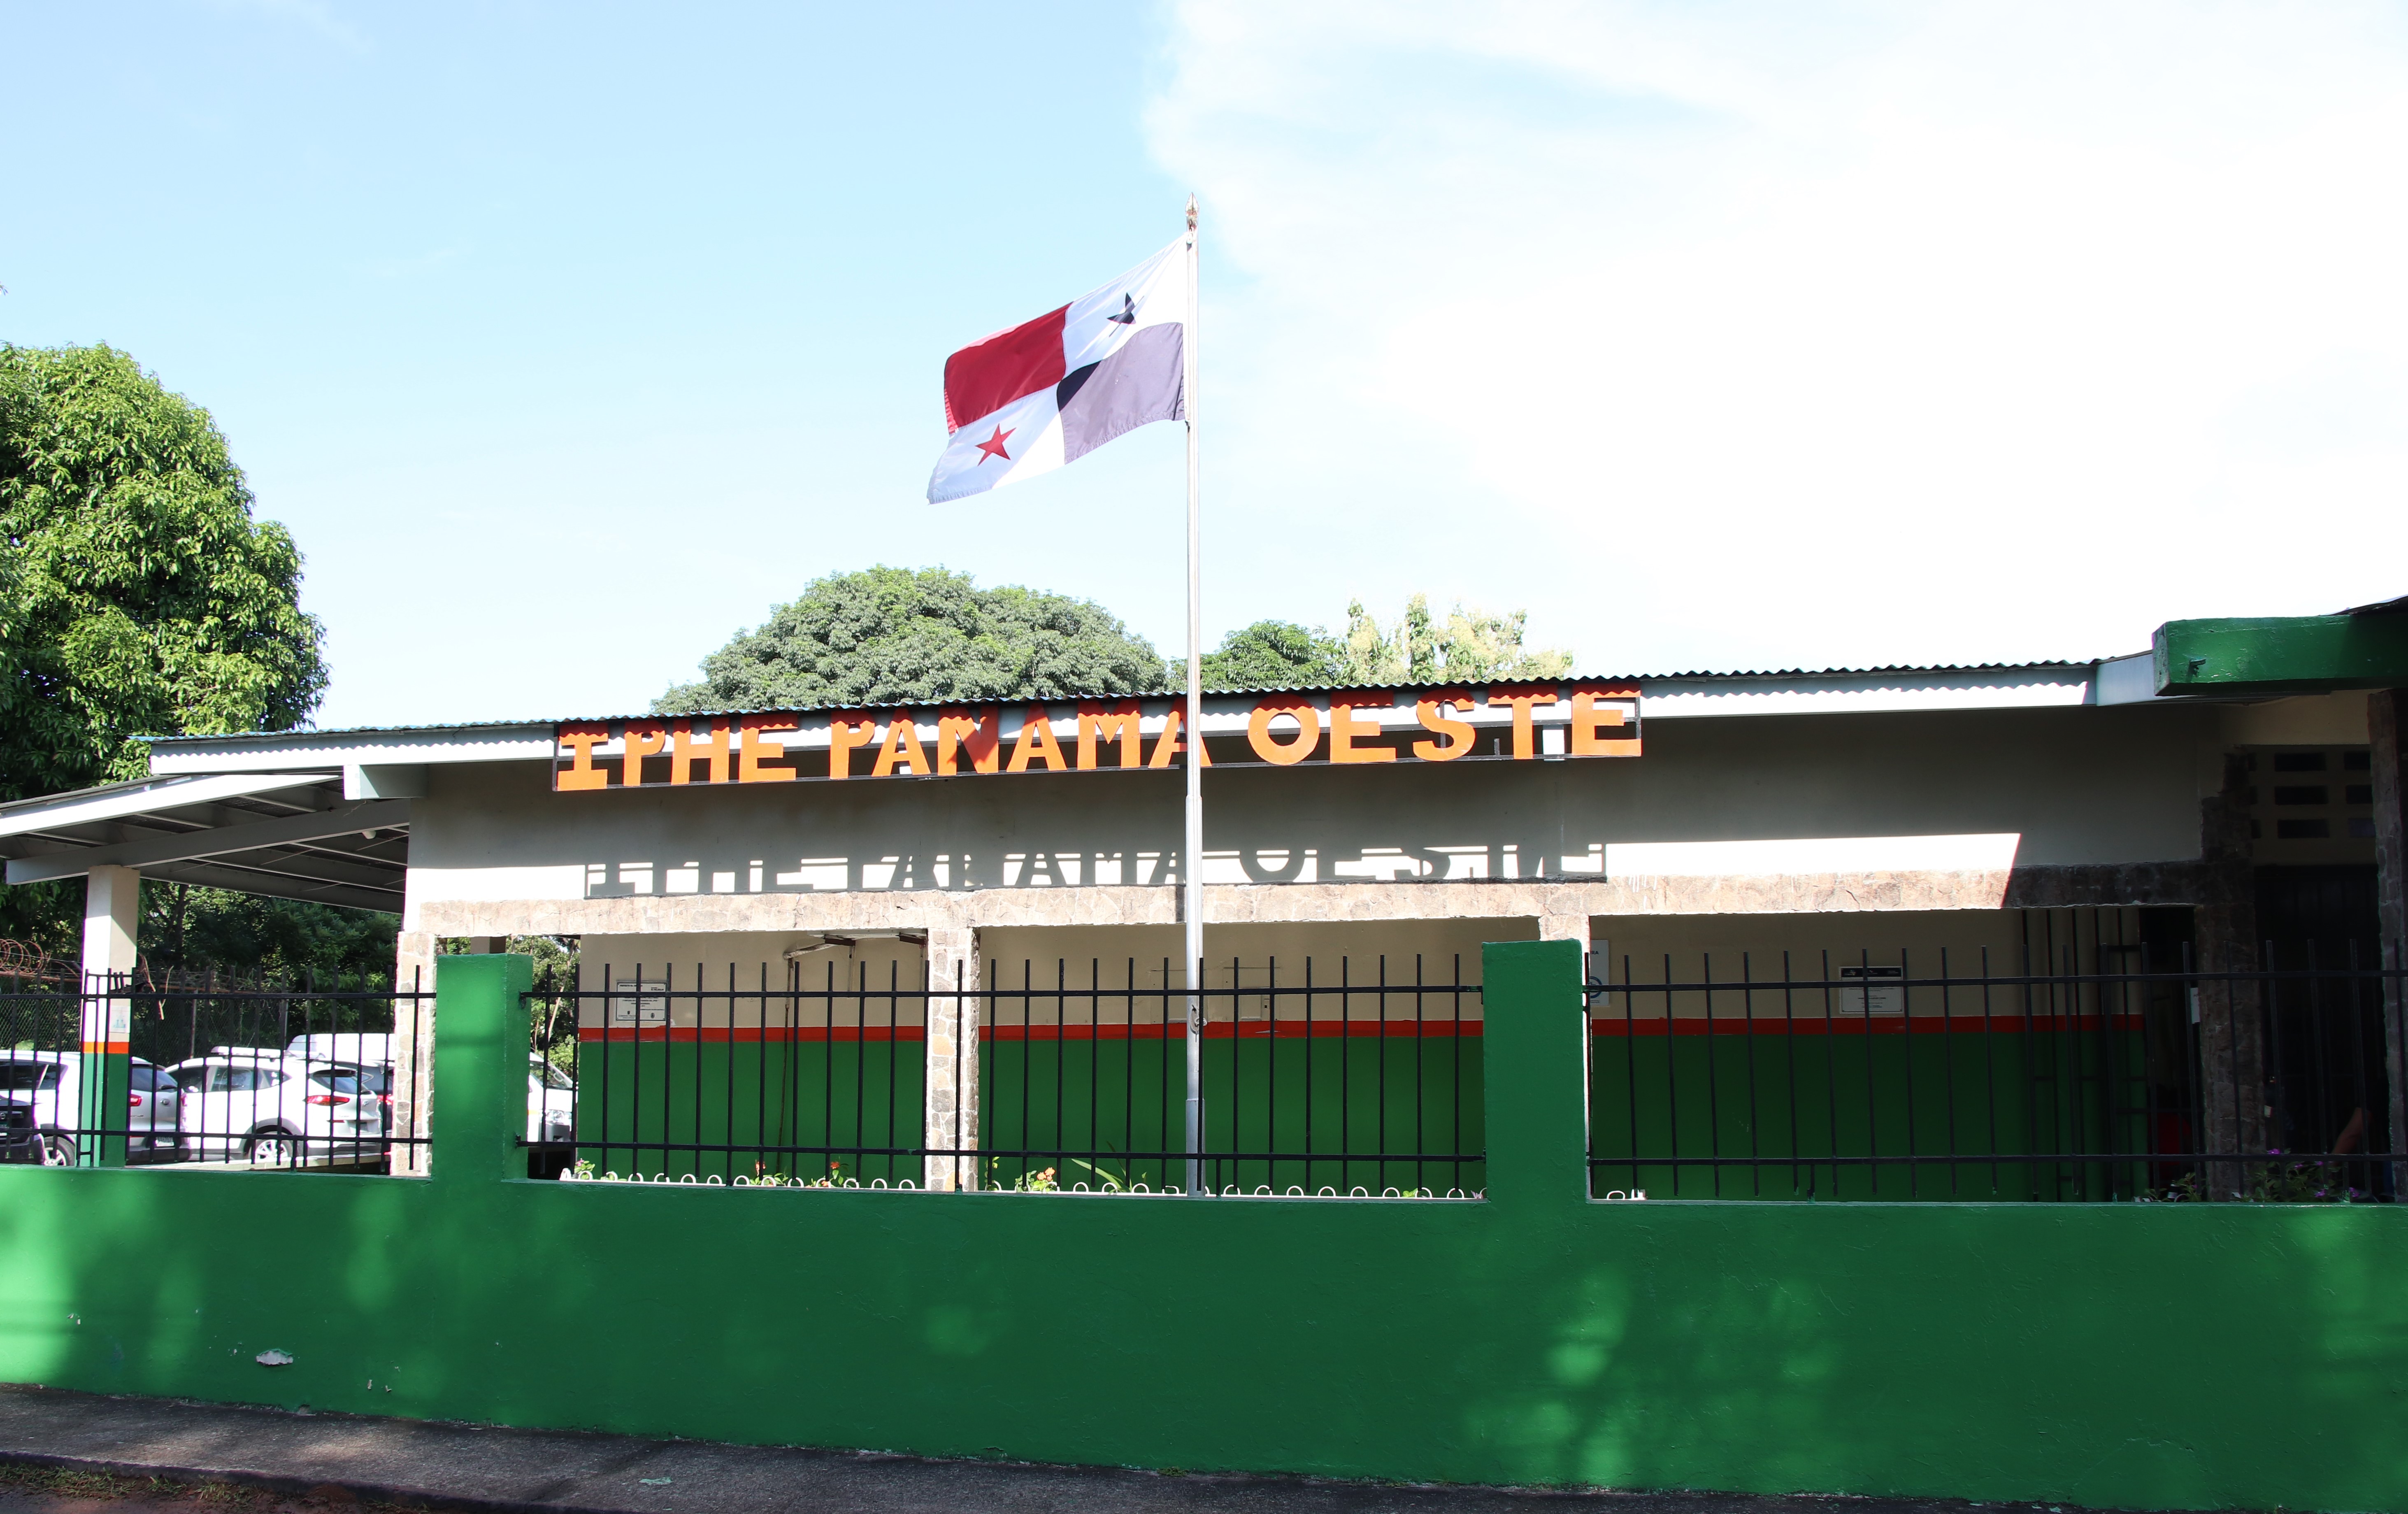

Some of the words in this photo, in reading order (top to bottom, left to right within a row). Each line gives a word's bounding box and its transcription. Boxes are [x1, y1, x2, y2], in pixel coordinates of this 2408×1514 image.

[557, 713, 797, 791] IPHE
[829, 697, 1212, 779] PANAMA
[1248, 683, 1641, 765] OESTE
